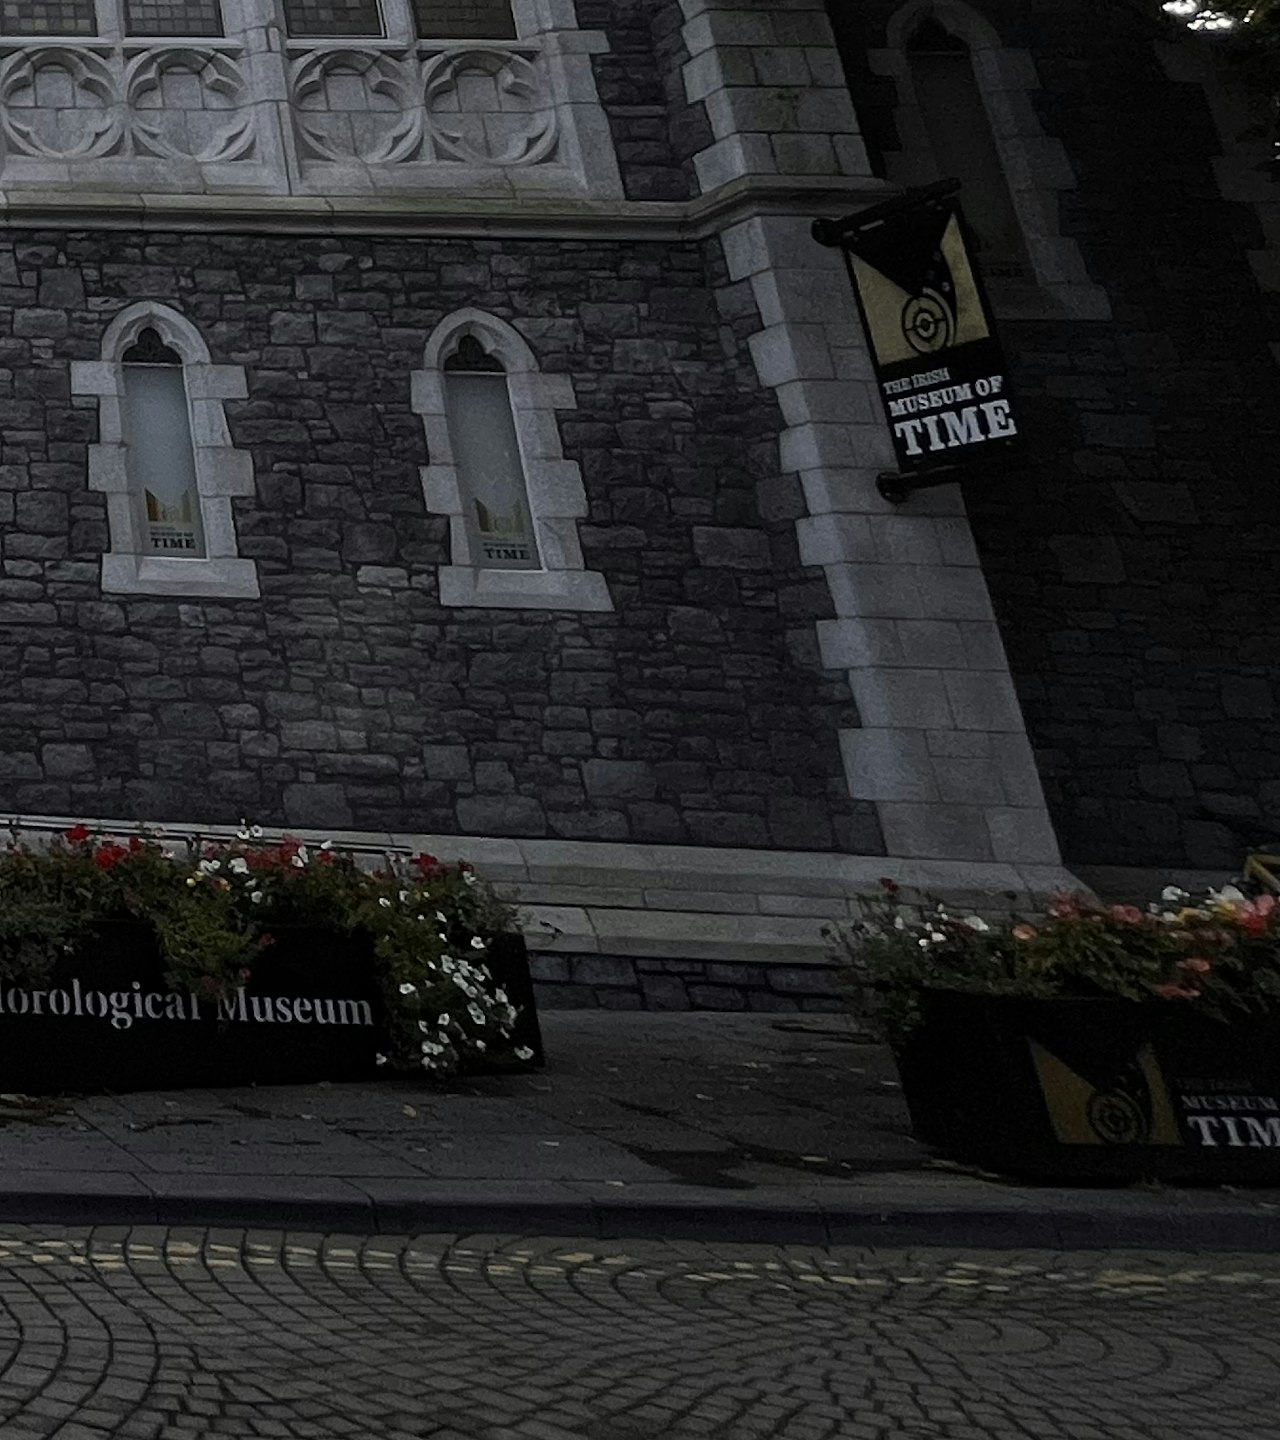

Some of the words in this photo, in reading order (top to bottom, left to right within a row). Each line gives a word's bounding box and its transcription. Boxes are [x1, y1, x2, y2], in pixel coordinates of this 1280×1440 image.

[882, 377, 912, 395] THE
[911, 367, 951, 388] IRISH
[888, 383, 974, 417] MUSEUM
[975, 375, 1003, 396] OF
[894, 399, 1018, 456] TIME
[151, 537, 196, 548] TIME
[484, 548, 529, 560] TIME
[217, 986, 374, 1026] Museum
[1180, 1095, 1279, 1111] MUSEUM
